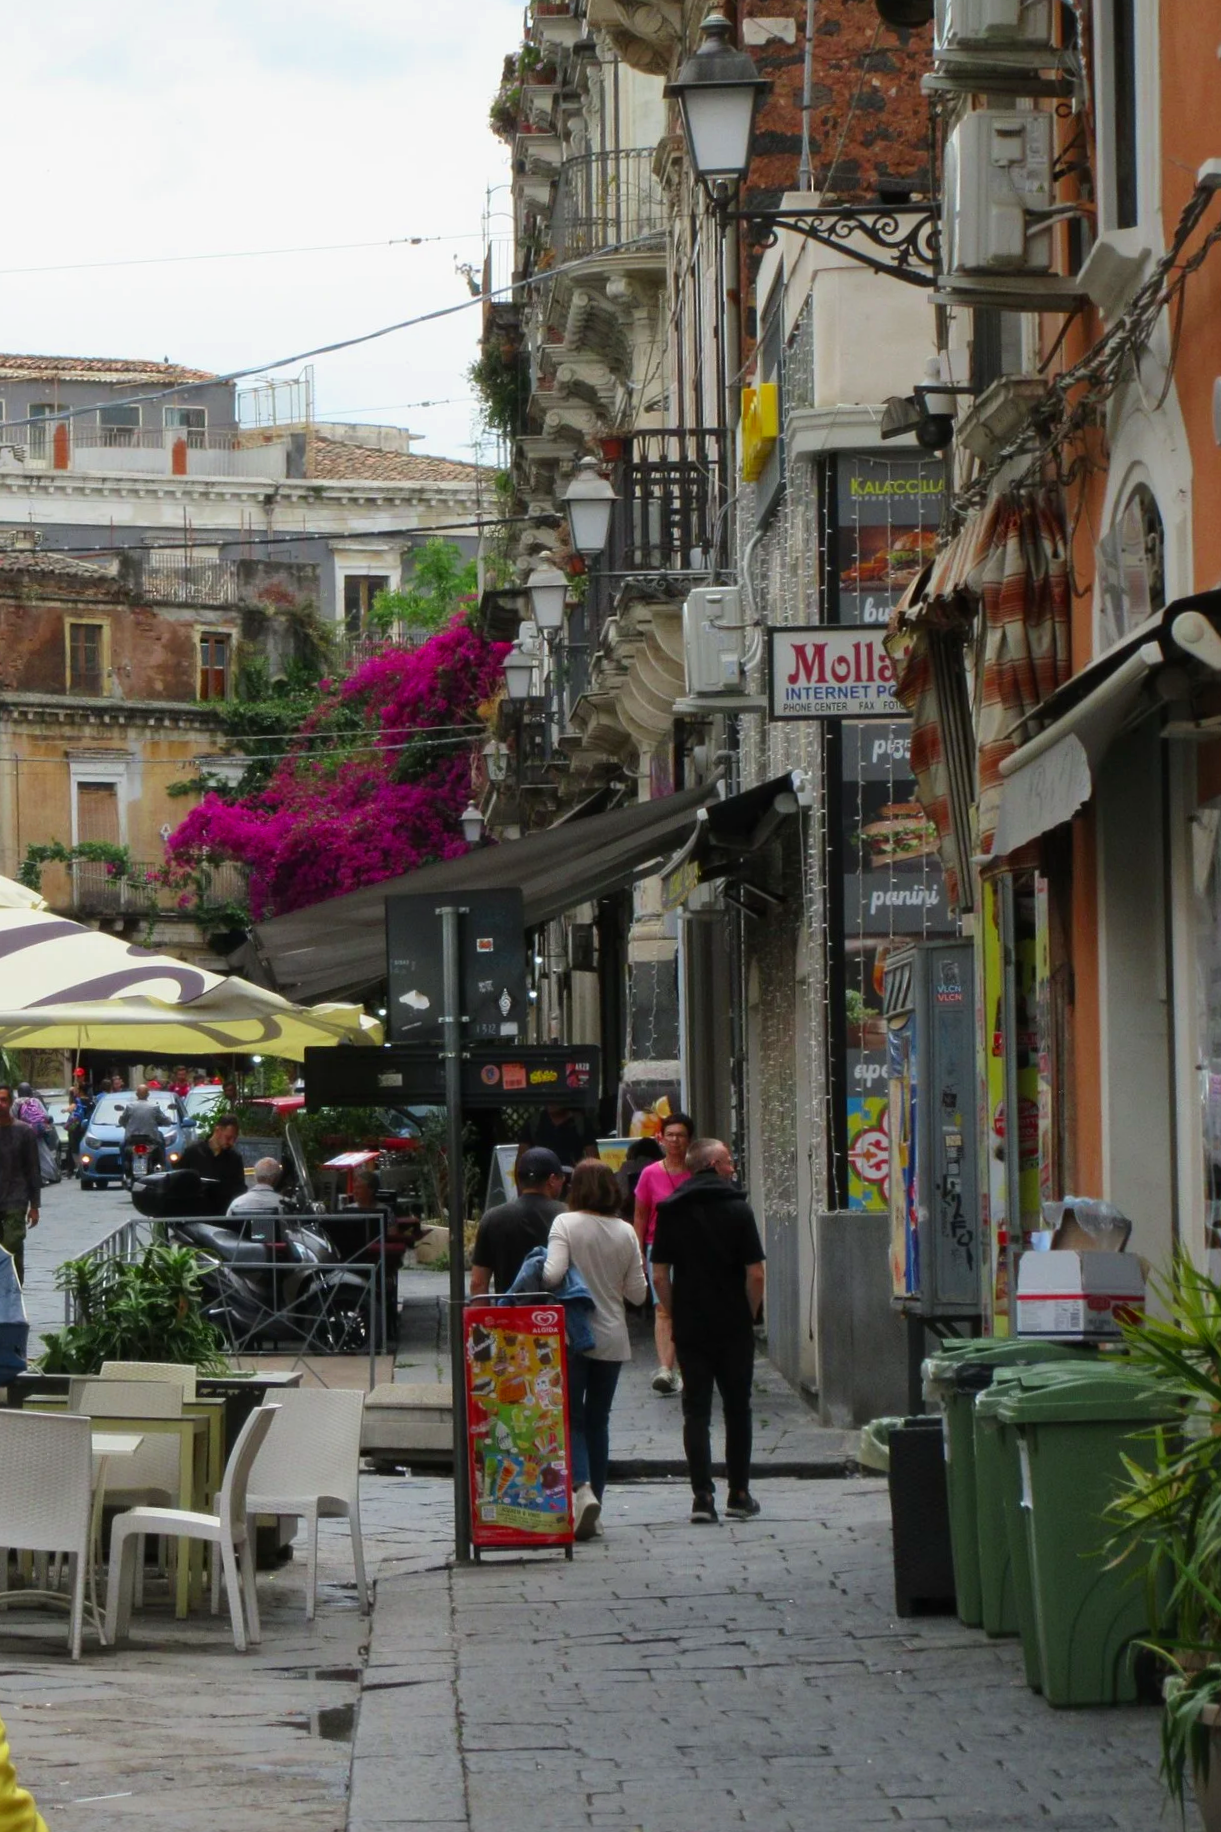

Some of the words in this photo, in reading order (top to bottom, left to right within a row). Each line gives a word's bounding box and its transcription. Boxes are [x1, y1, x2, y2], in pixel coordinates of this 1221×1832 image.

[786, 685, 871, 700] INTERNET
[783, 703, 812, 712] PHONE
[814, 702, 848, 712] CENTER
[859, 702, 874, 710] FAX
[870, 884, 940, 915] panini
